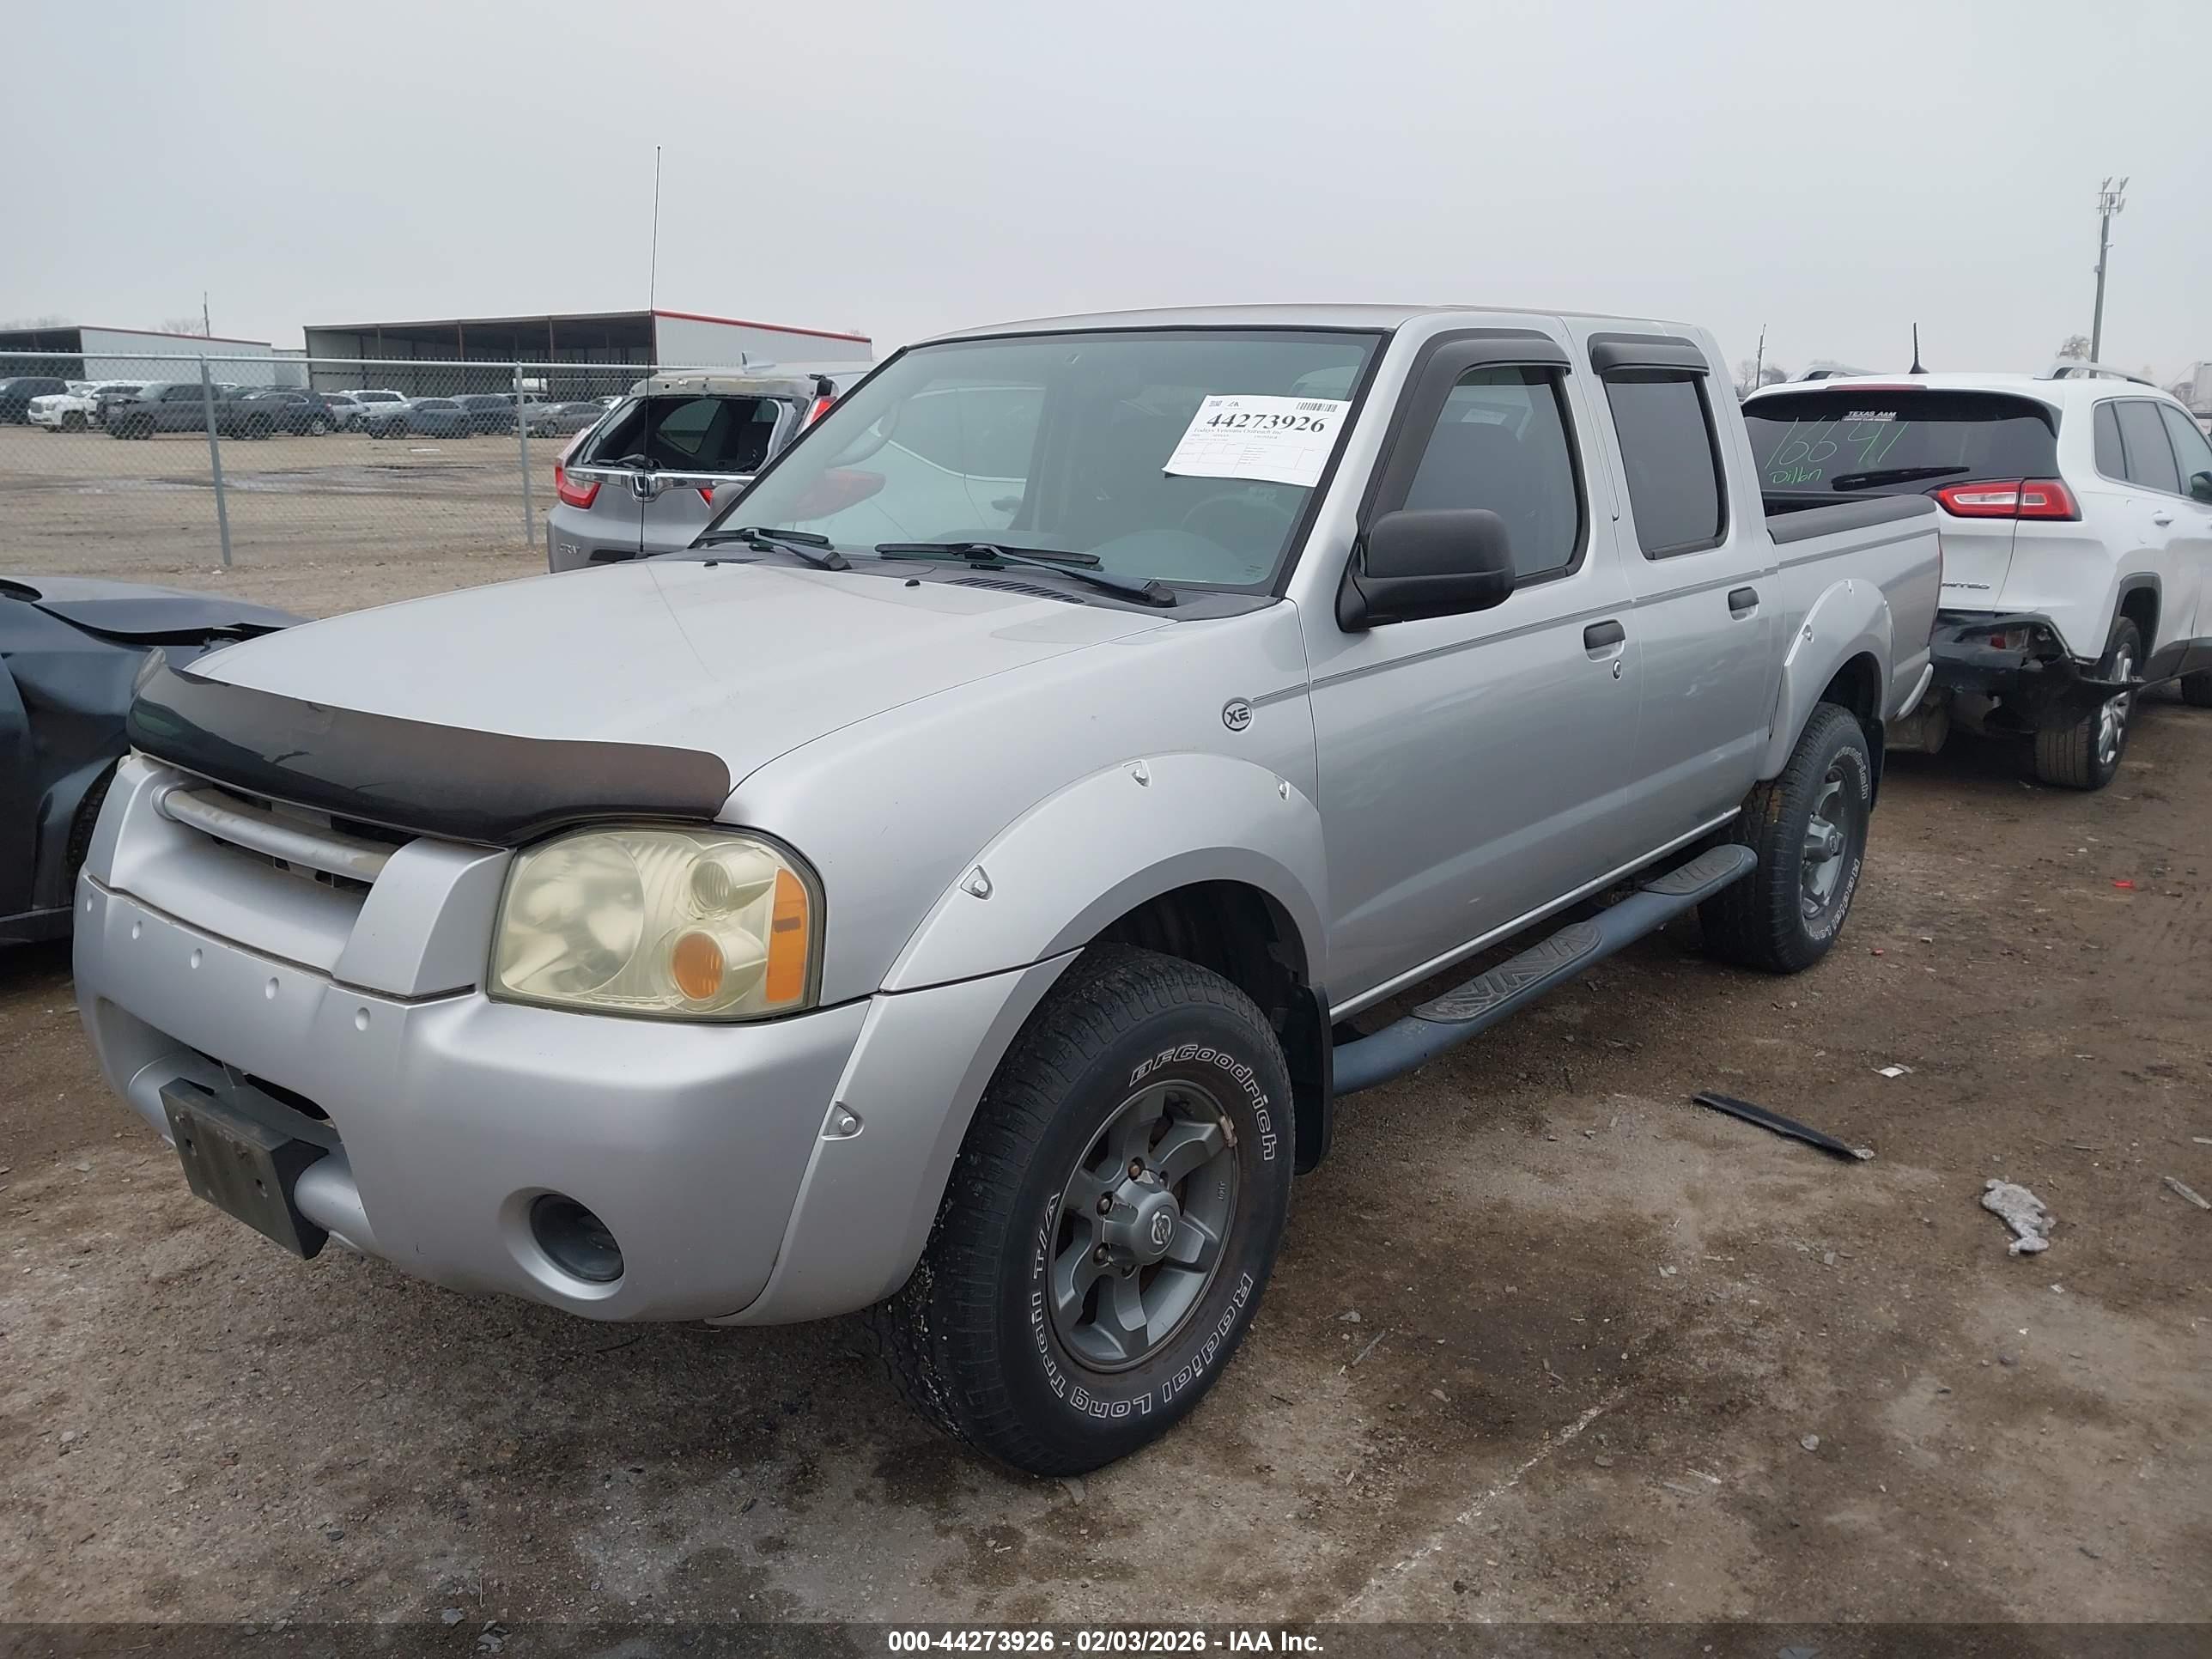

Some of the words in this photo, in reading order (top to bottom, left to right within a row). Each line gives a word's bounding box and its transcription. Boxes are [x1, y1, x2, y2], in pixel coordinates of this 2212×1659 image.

[1206, 414, 1328, 432] 44273926
[1769, 466, 1822, 483] Dillon
[1226, 707, 1250, 725] XE
[1129, 1044, 1277, 1161] BFGoodrich
[1033, 1192, 1060, 1279] T/A
[1031, 1291, 1066, 1398] Trail
[1161, 1273, 1254, 1403] Radial
[1070, 1386, 1152, 1418] Long
